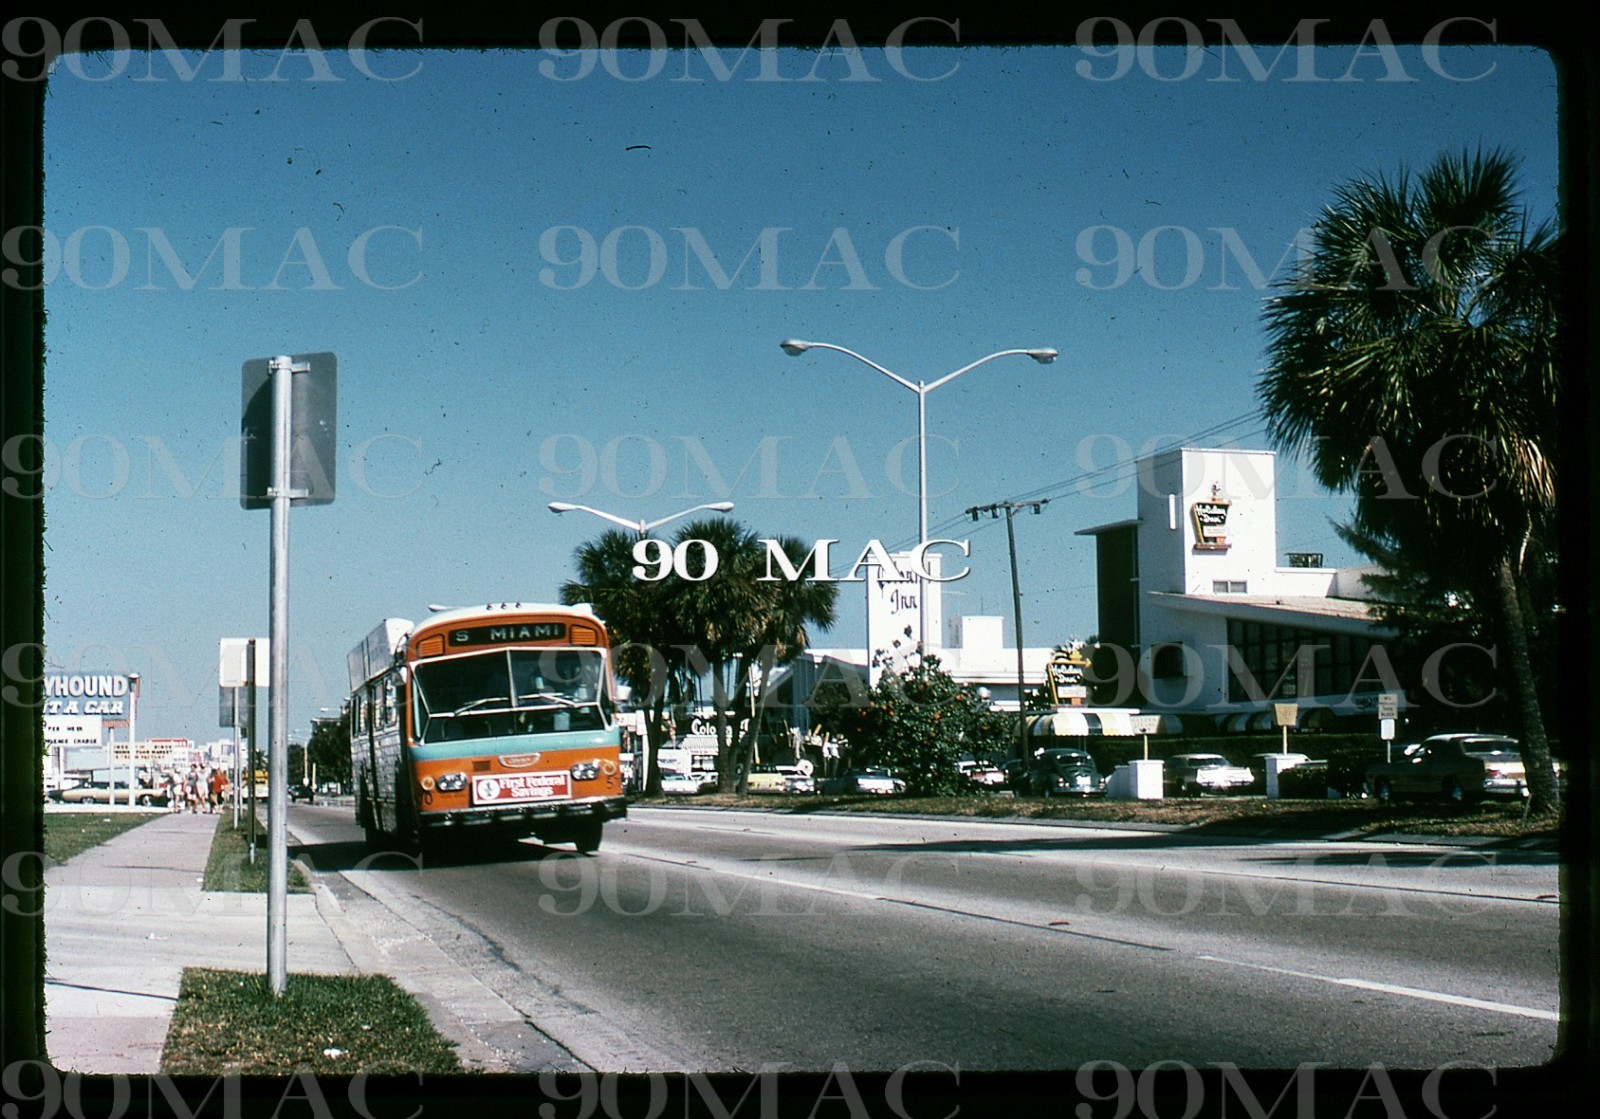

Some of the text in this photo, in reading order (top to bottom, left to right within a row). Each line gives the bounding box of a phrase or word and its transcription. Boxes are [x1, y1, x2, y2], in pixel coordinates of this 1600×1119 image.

[890, 589, 918, 615] Inn
[455, 624, 561, 642] S MIAMI
[63, 700, 79, 714] A
[84, 700, 123, 714] CAR
[499, 774, 566, 790] First Federal
[510, 786, 554, 798] Savings
